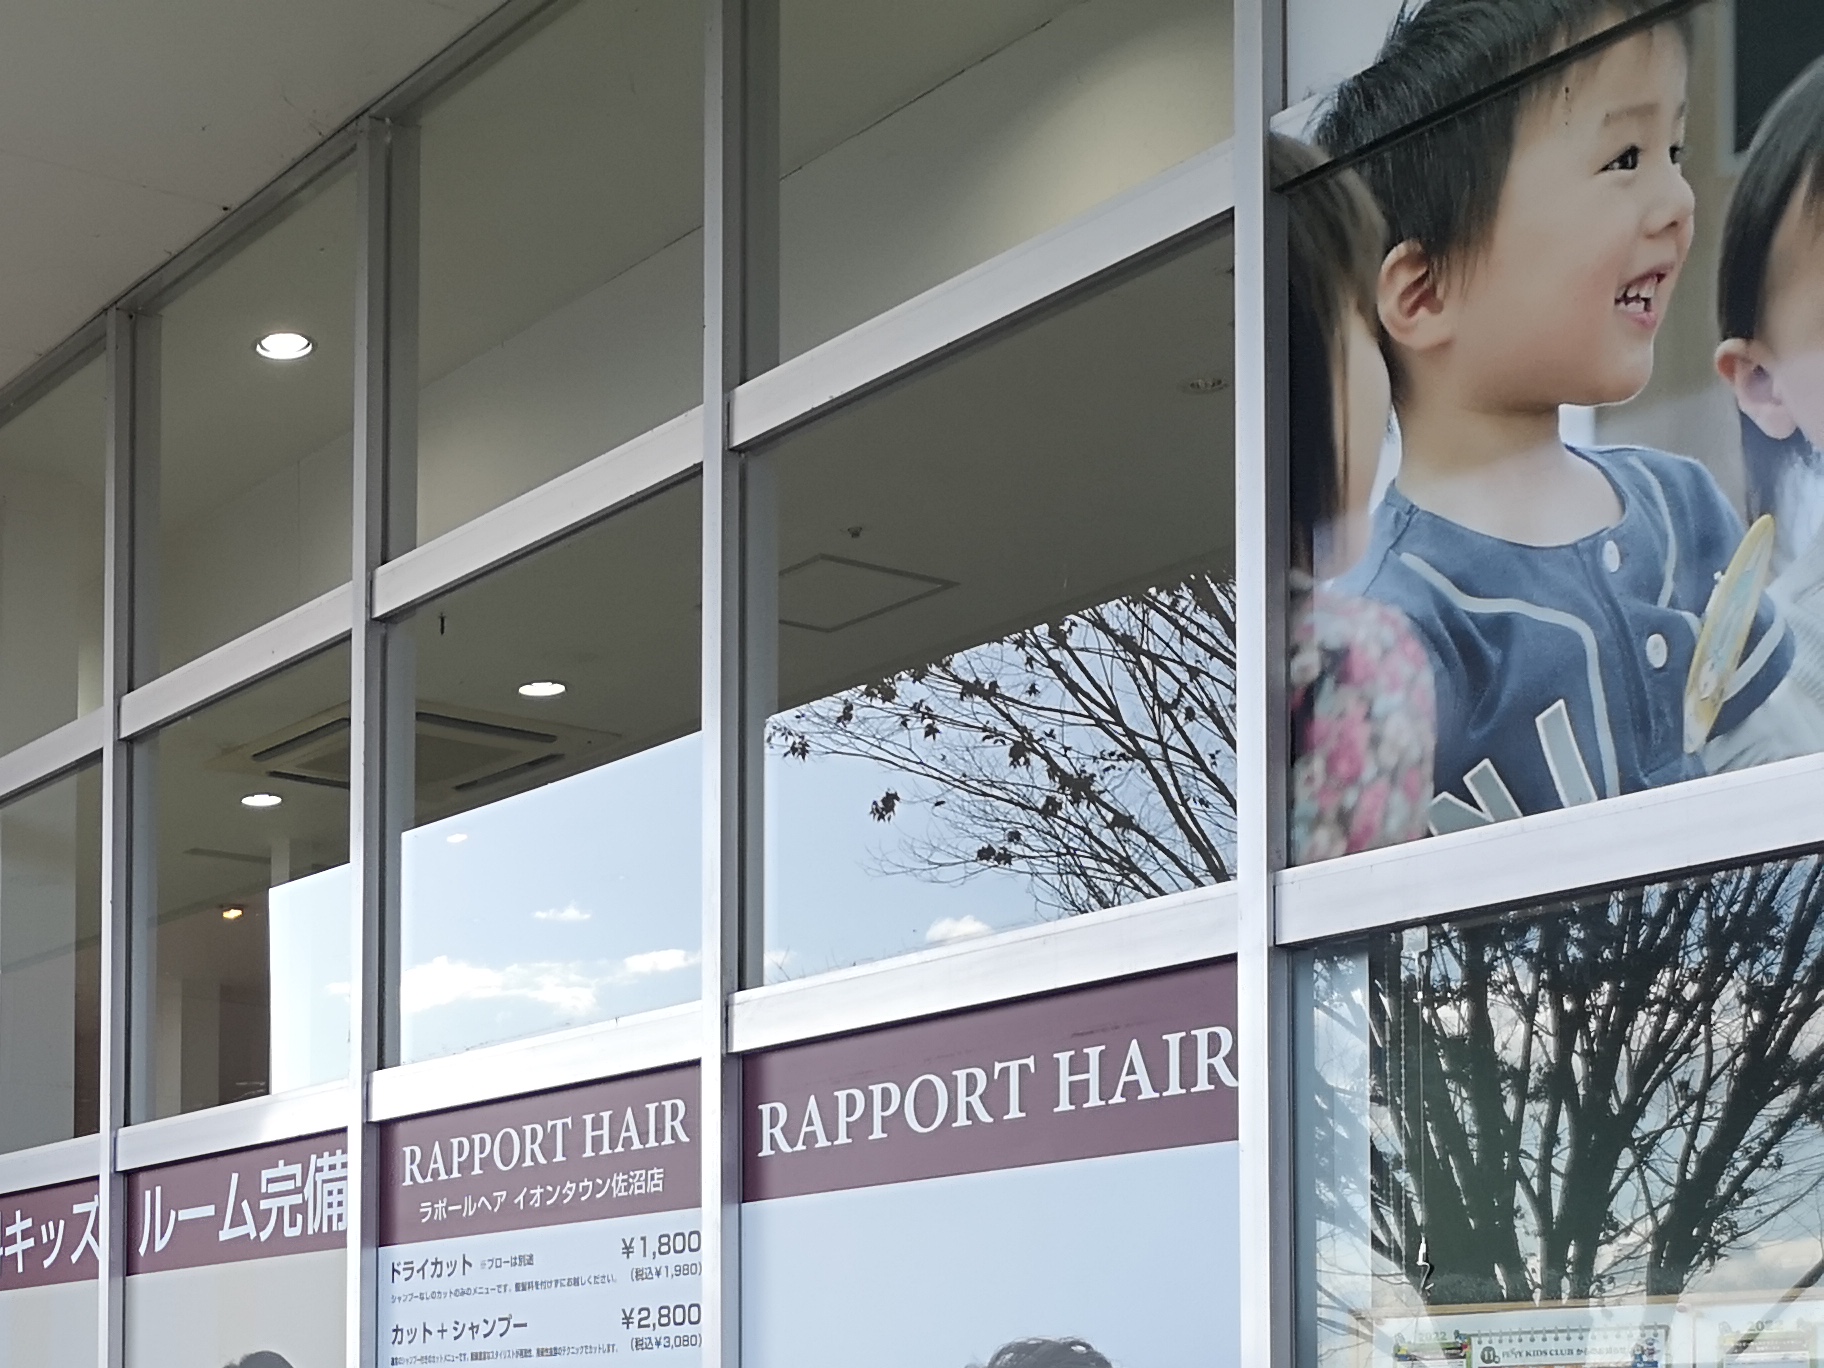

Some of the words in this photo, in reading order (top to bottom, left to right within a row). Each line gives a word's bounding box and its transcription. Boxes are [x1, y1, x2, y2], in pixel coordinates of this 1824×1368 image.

[758, 1054, 1036, 1158] RAPPORT
[1053, 1026, 1239, 1113] HAIR
[402, 1116, 572, 1187] RAPPORT
[582, 1098, 690, 1158] HAIR
[138, 1149, 348, 1257] ルーム完備
[419, 1190, 507, 1223] ラポールヘア
[514, 1167, 664, 1210] イオンタウン佐沼店
[622, 1230, 702, 1259] ¥1,800
[391, 1253, 472, 1283] ドライカット
[622, 1302, 702, 1330] ¥2,800
[1525, 1348, 1548, 1358] KIDS
[1549, 1347, 1574, 1357] CLUB
